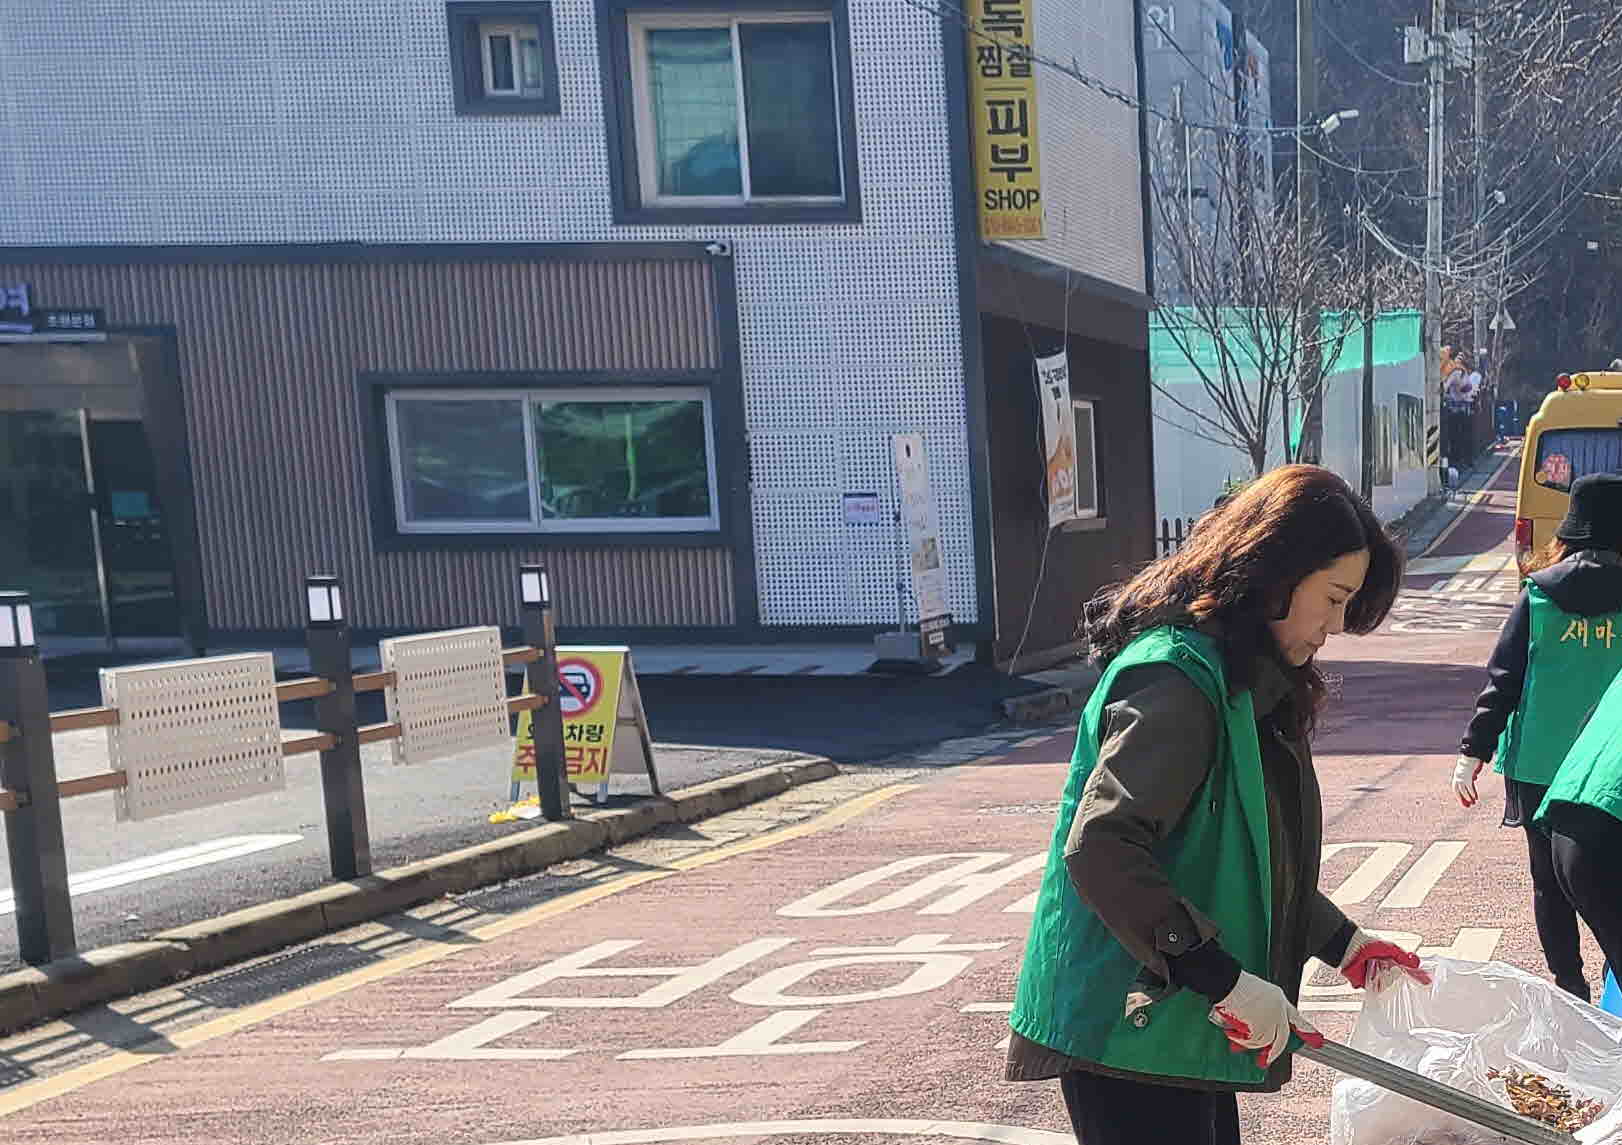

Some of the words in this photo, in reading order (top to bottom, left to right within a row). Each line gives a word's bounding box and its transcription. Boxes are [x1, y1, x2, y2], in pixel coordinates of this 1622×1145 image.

[986, 99, 1032, 183] 피부
[984, 189, 1040, 211] SHOP
[515, 744, 607, 776] 주금지
